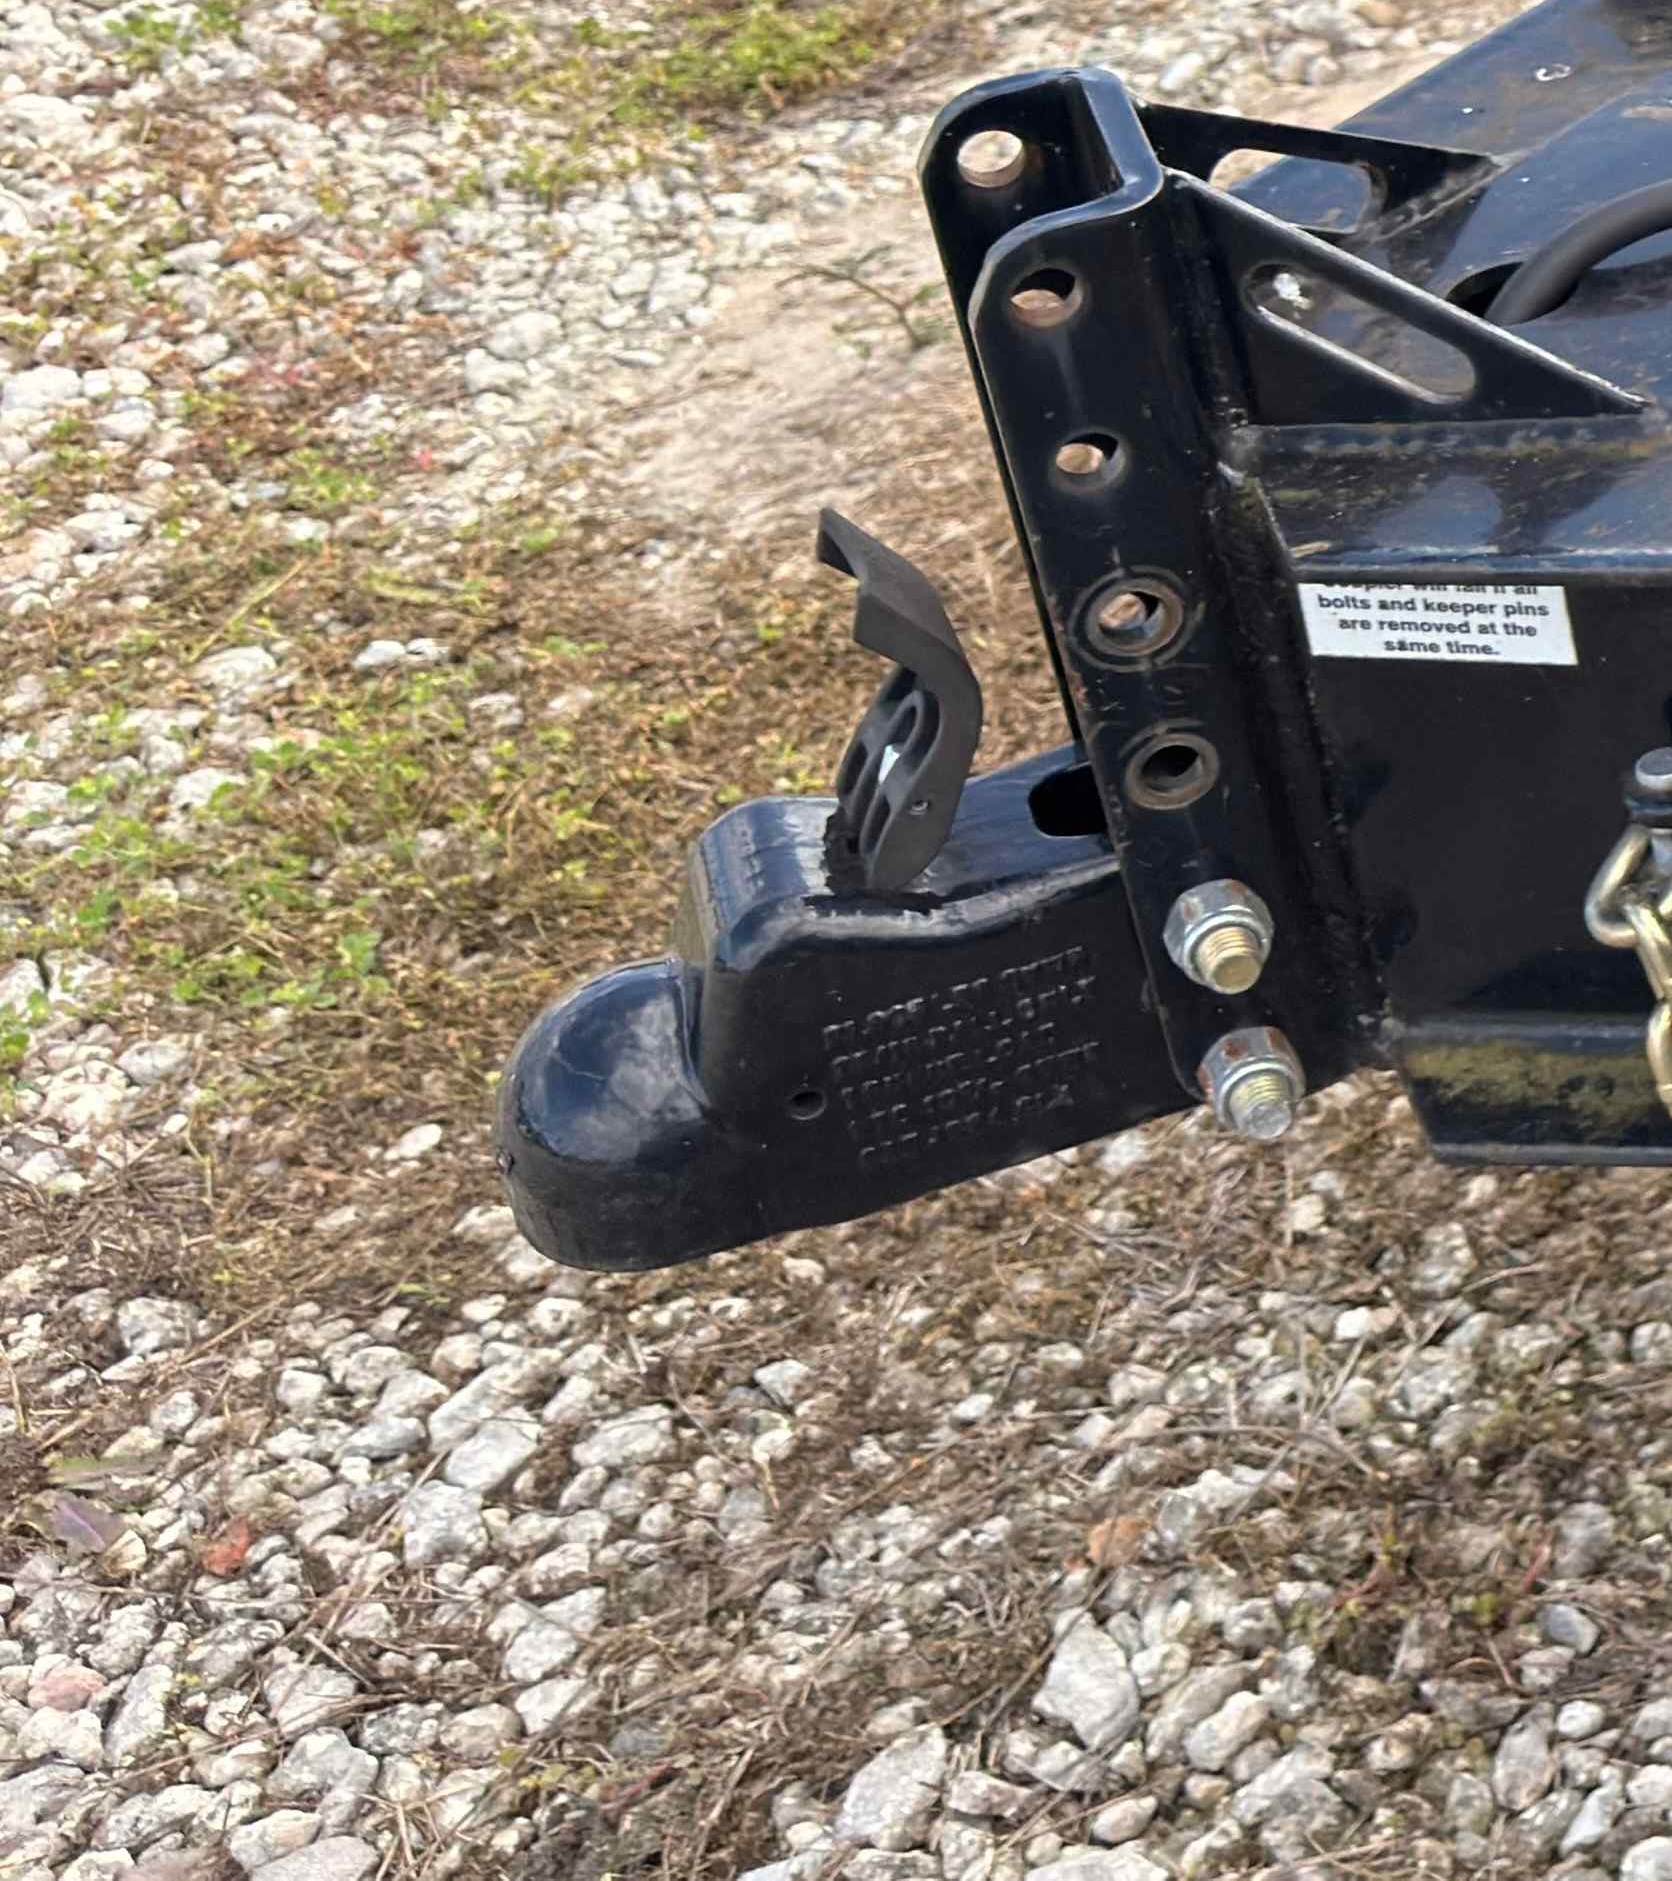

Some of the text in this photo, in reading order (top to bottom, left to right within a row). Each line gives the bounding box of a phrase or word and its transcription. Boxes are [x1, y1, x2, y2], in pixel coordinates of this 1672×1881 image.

[1318, 594, 1550, 618] bolts and keeper pins
[1339, 619, 1537, 637] are removed at the
[1384, 639, 1501, 655] same time.
